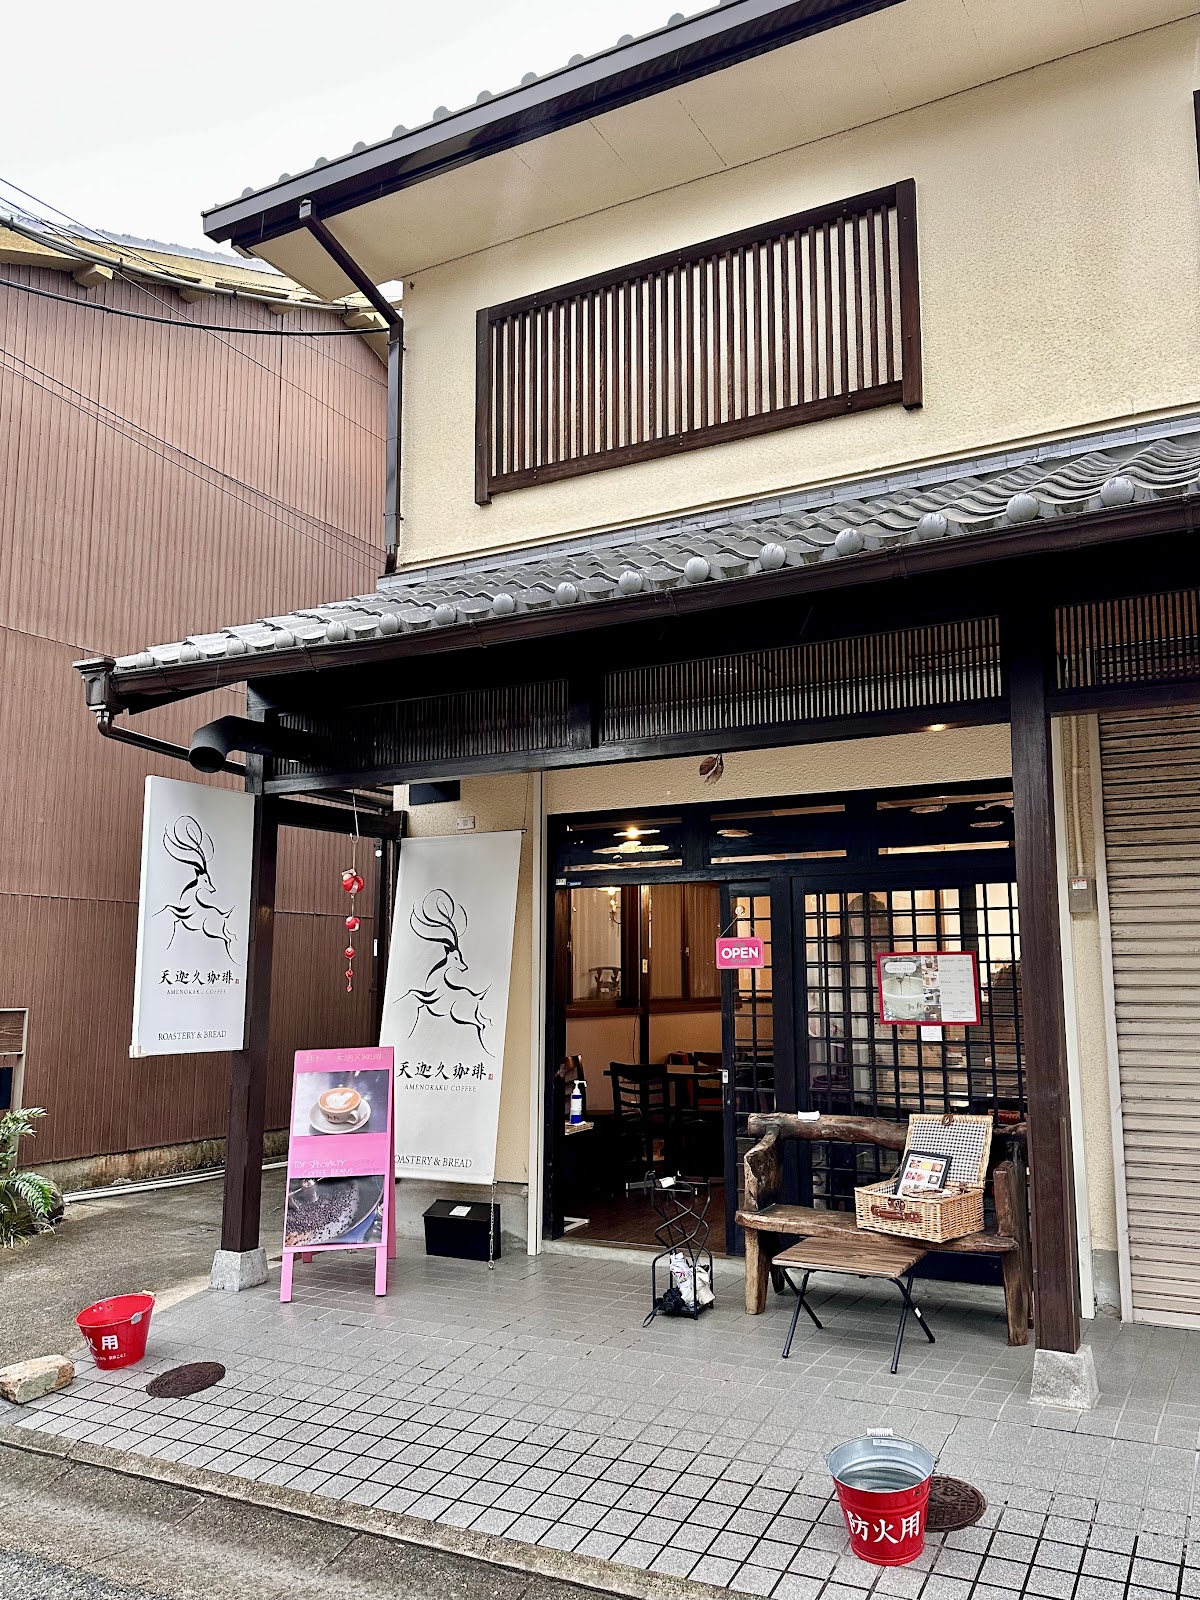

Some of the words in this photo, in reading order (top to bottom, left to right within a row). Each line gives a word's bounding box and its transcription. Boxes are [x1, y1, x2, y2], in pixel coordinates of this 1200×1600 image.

[721, 946, 759, 959] OPEN
[158, 969, 234, 986] 天迦久珈琲
[158, 1032, 195, 1041] ROASTERY
[196, 1031, 203, 1039] &
[203, 1030, 227, 1039] BREAD
[396, 1060, 487, 1081] 天迦久珈琲
[404, 1083, 449, 1091] AMENOKAKU
[450, 1085, 477, 1093] COFFEE
[394, 1154, 433, 1166] OASTERY
[433, 1156, 441, 1167] &
[442, 1157, 473, 1169] BREAD
[845, 1508, 921, 1544] 防火用
